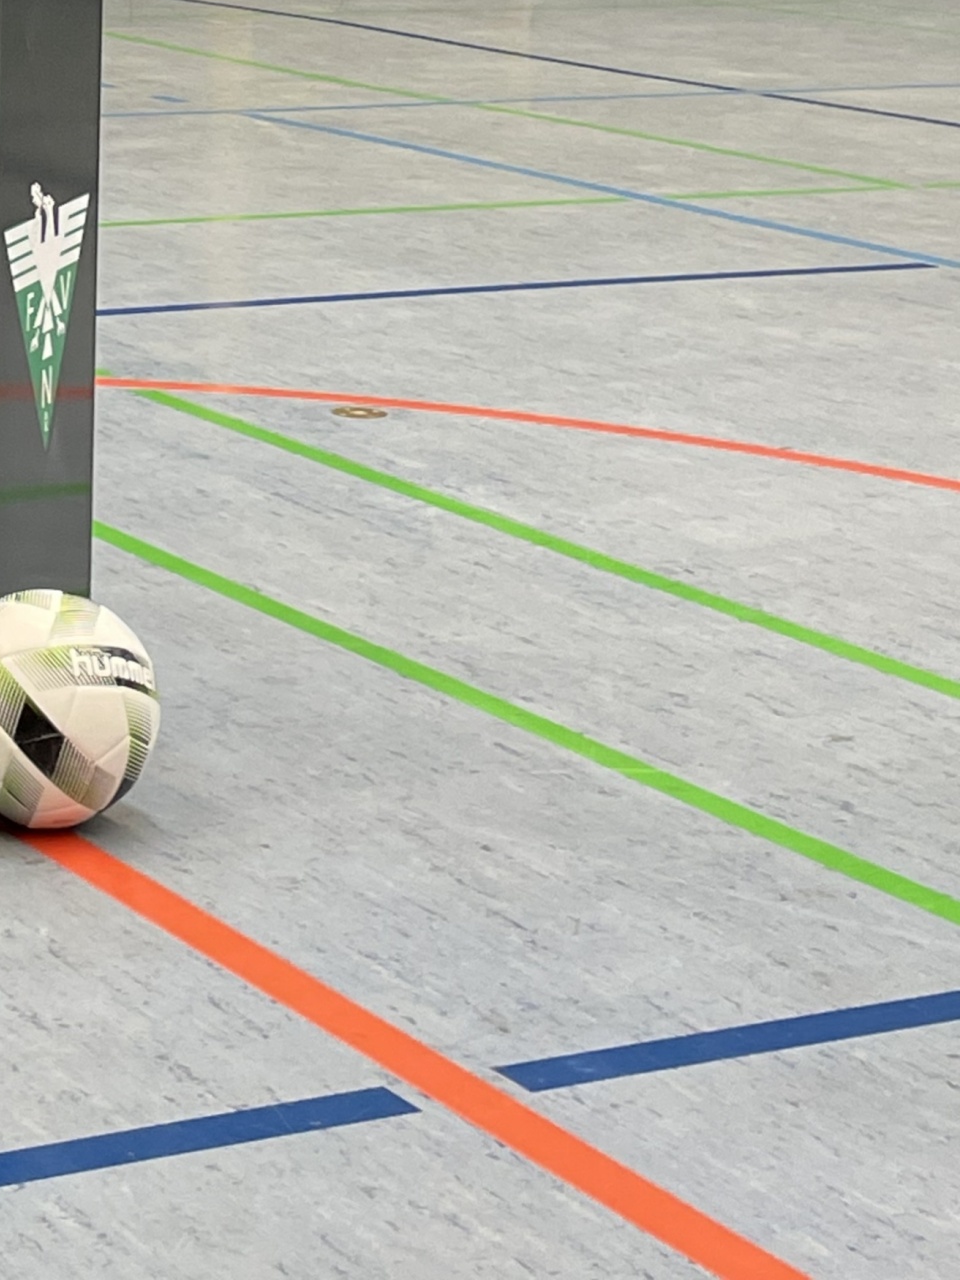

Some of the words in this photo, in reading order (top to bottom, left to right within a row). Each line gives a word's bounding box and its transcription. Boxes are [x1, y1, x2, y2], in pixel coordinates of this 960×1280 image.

[26, 291, 36, 332] F
[60, 270, 72, 310] V
[41, 365, 54, 408] N
